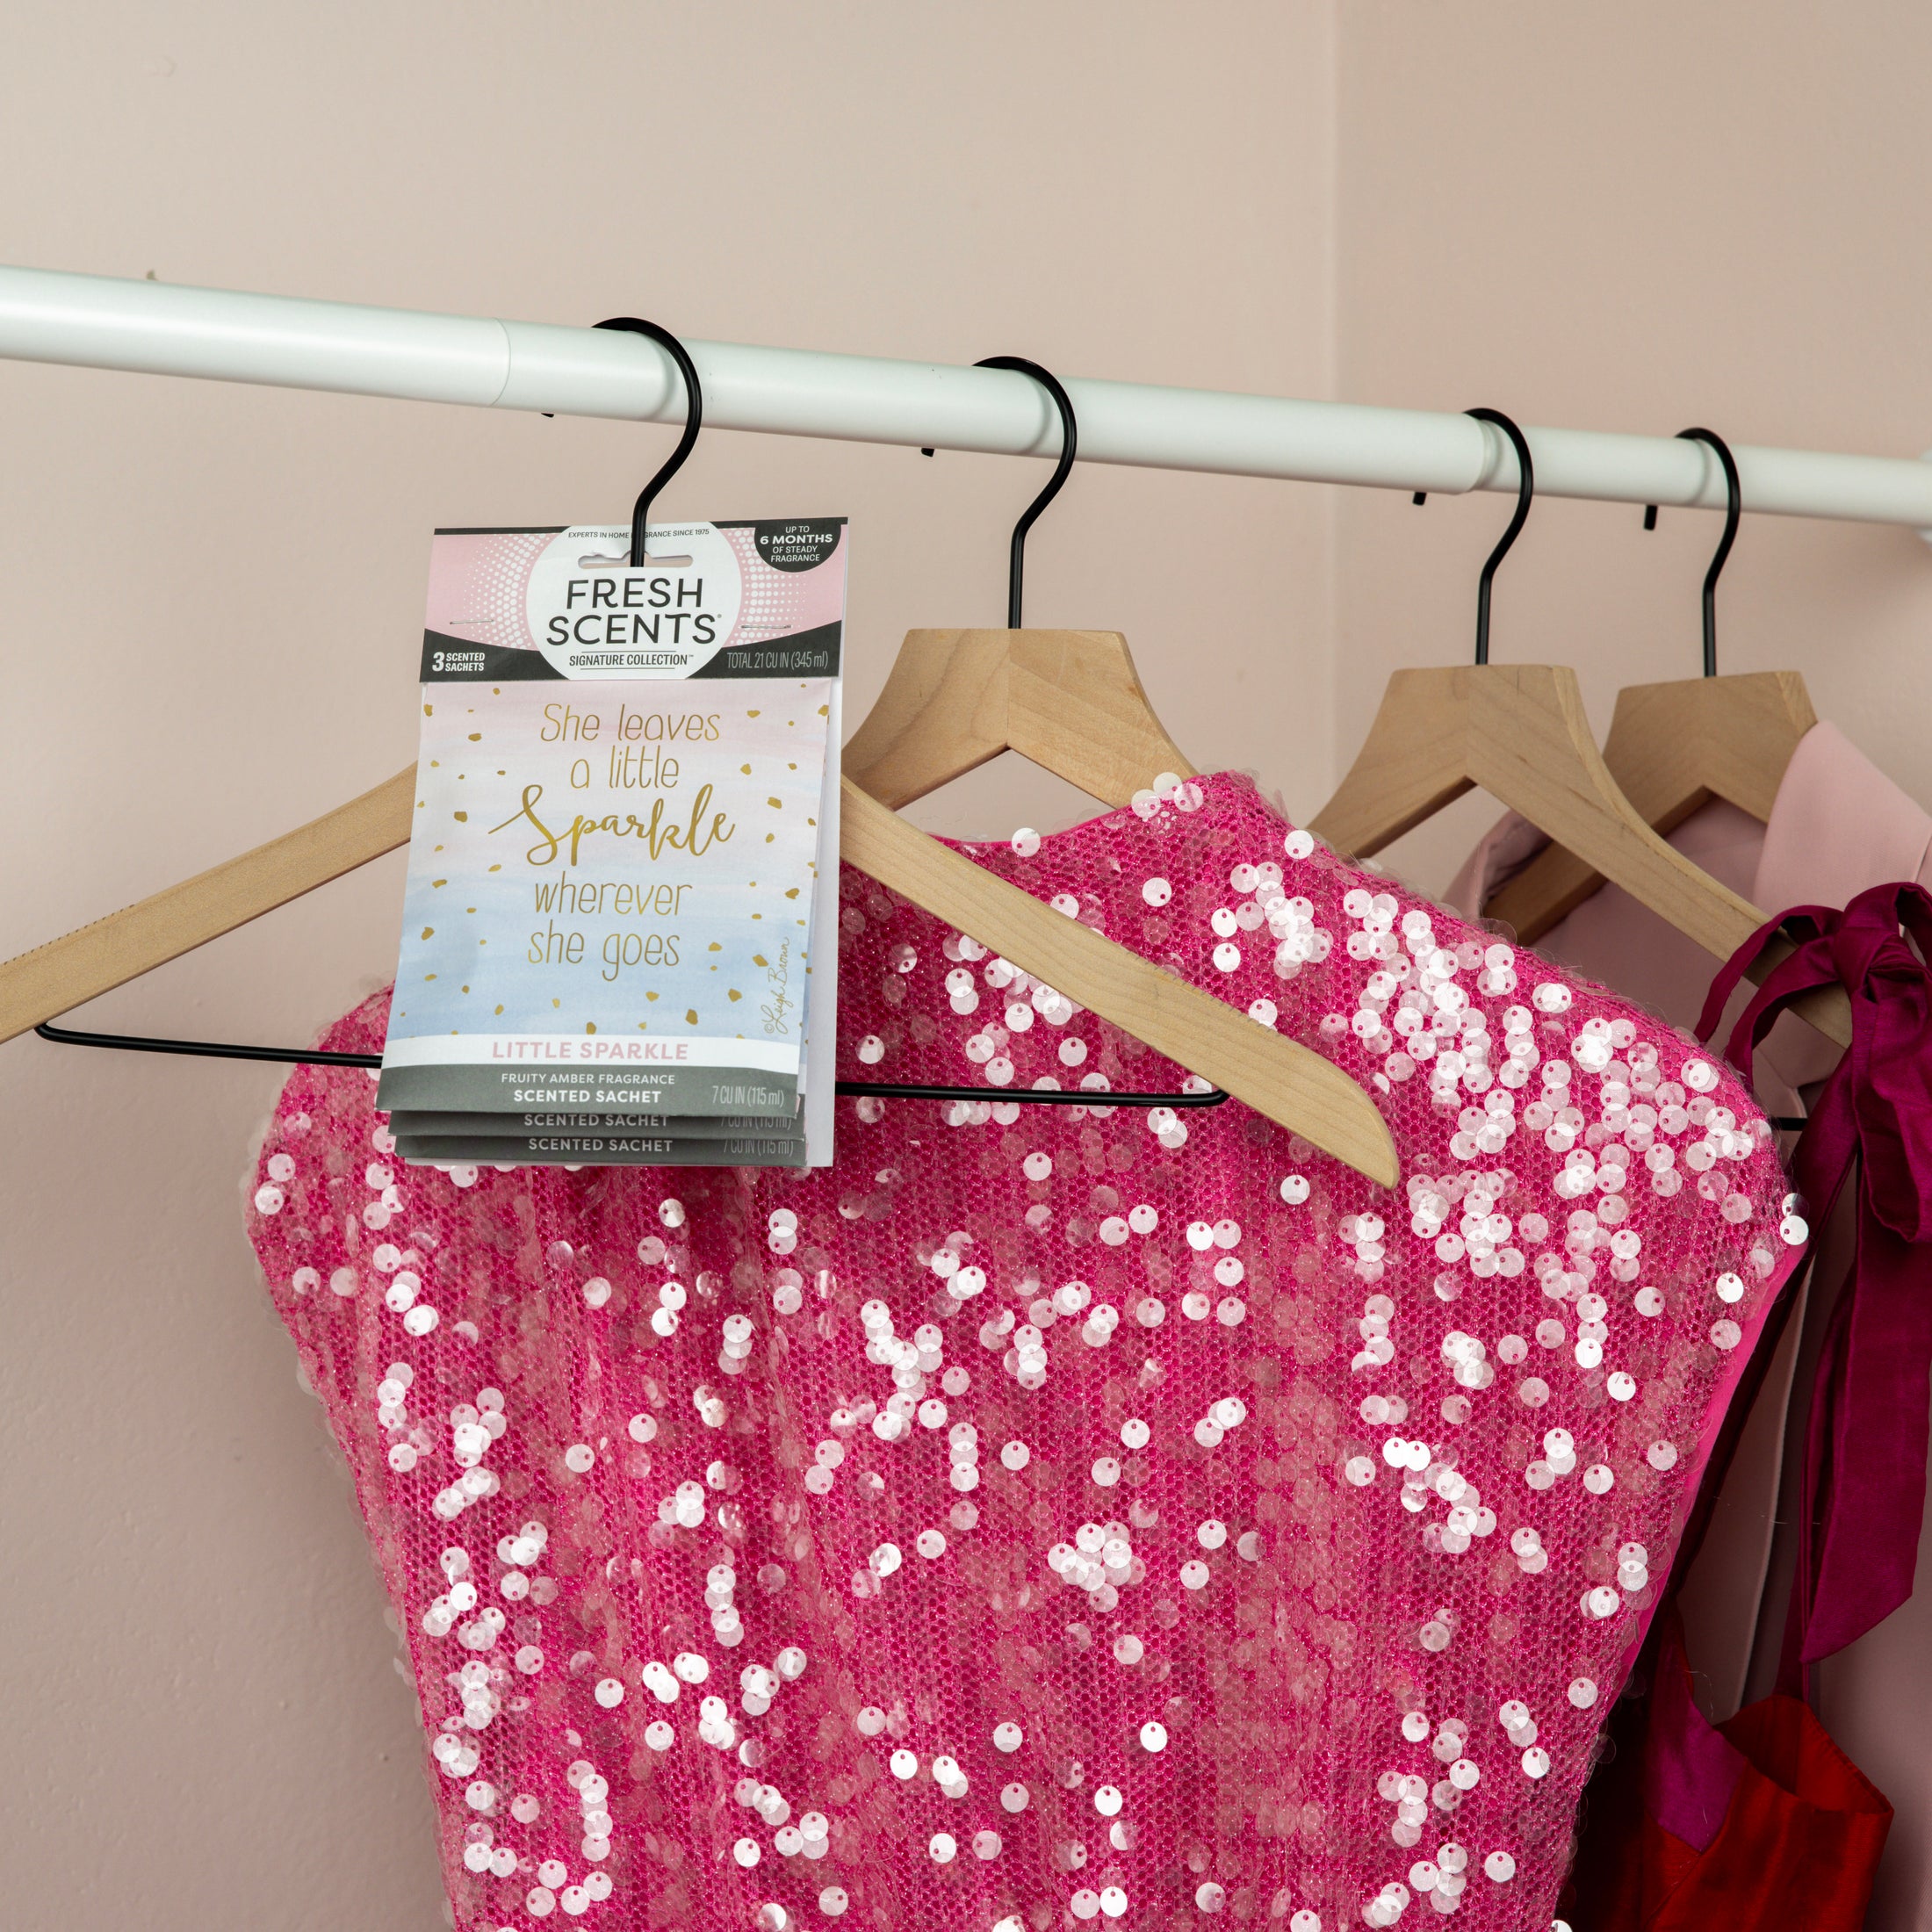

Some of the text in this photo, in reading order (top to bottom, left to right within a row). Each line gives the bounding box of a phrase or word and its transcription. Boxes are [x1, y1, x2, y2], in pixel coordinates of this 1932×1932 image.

[760, 534, 833, 544] 6 MONTHS
[566, 577, 703, 609] FRESH
[432, 652, 444, 672] 3
[445, 652, 485, 661] SCENTED
[569, 654, 626, 666] SIGNATURE
[726, 651, 828, 670] TOTAL 21 CU IN (345 ml)
[444, 662, 485, 672] SACHETS
[540, 703, 721, 742] She leaves
[570, 745, 680, 789] a little
[487, 783, 736, 867] Sparkle
[534, 870, 693, 916] wherever
[528, 919, 681, 982] she goes
[492, 1042, 688, 1060] LITTLE SPARKLE
[501, 1073, 675, 1085] FRUITY AMBER FRAGRANCE
[514, 1089, 661, 1104] SCENTED SACHET
[712, 1085, 784, 1108] 7 CU IN (115 ml)
[524, 1114, 669, 1127] SCENTED SACHET
[529, 1138, 673, 1152] SCENTED SACHET
